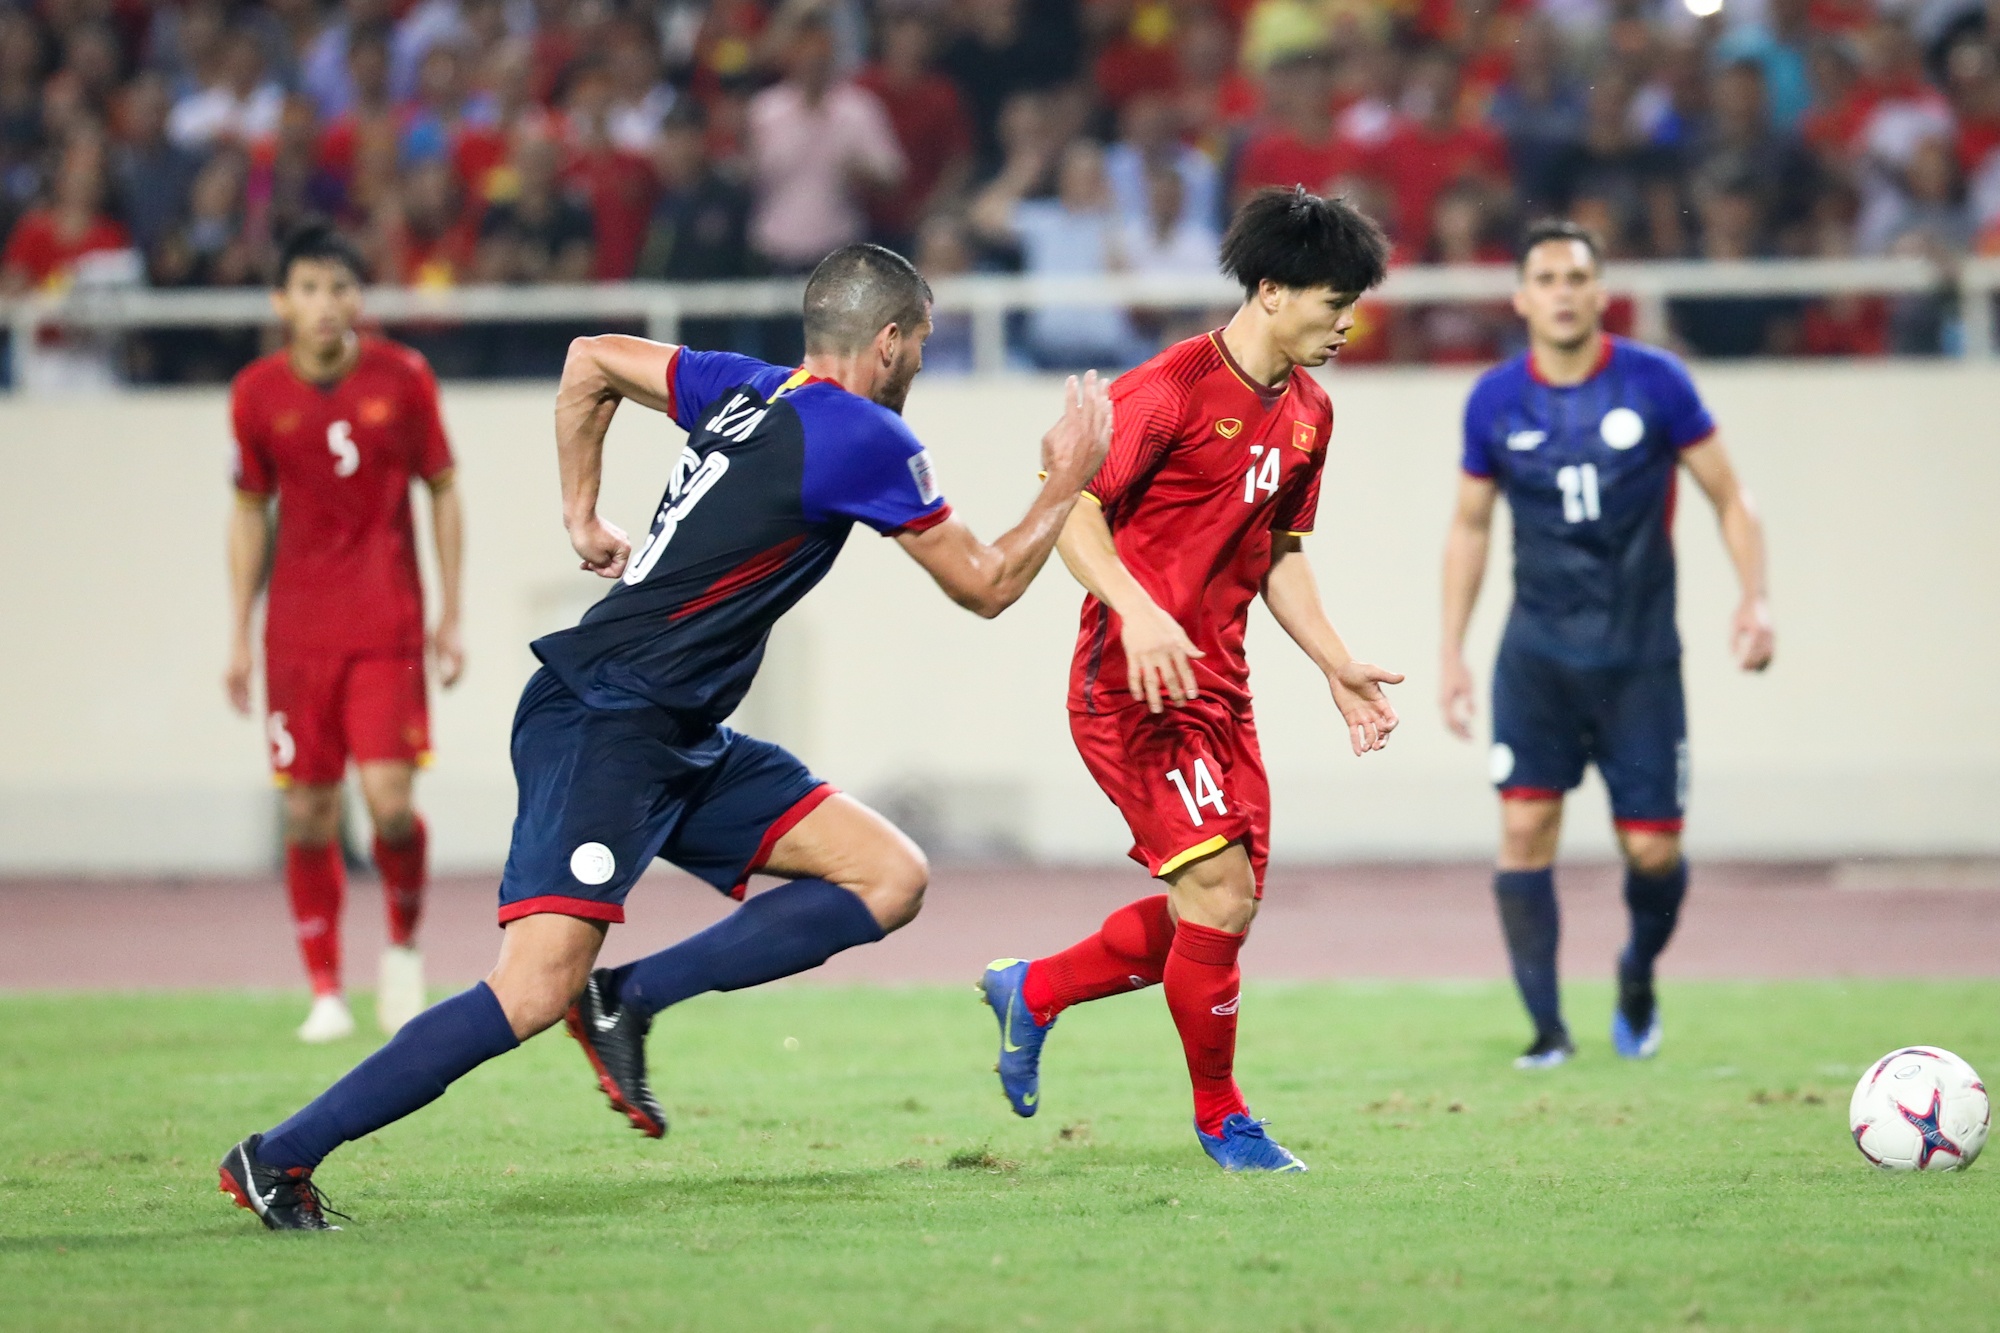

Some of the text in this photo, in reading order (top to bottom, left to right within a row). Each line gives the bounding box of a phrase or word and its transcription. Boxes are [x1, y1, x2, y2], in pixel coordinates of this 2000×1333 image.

[326, 420, 360, 478] 5
[1243, 444, 1281, 504] 14
[1556, 462, 1602, 524] 11
[1165, 757, 1228, 827] 14
